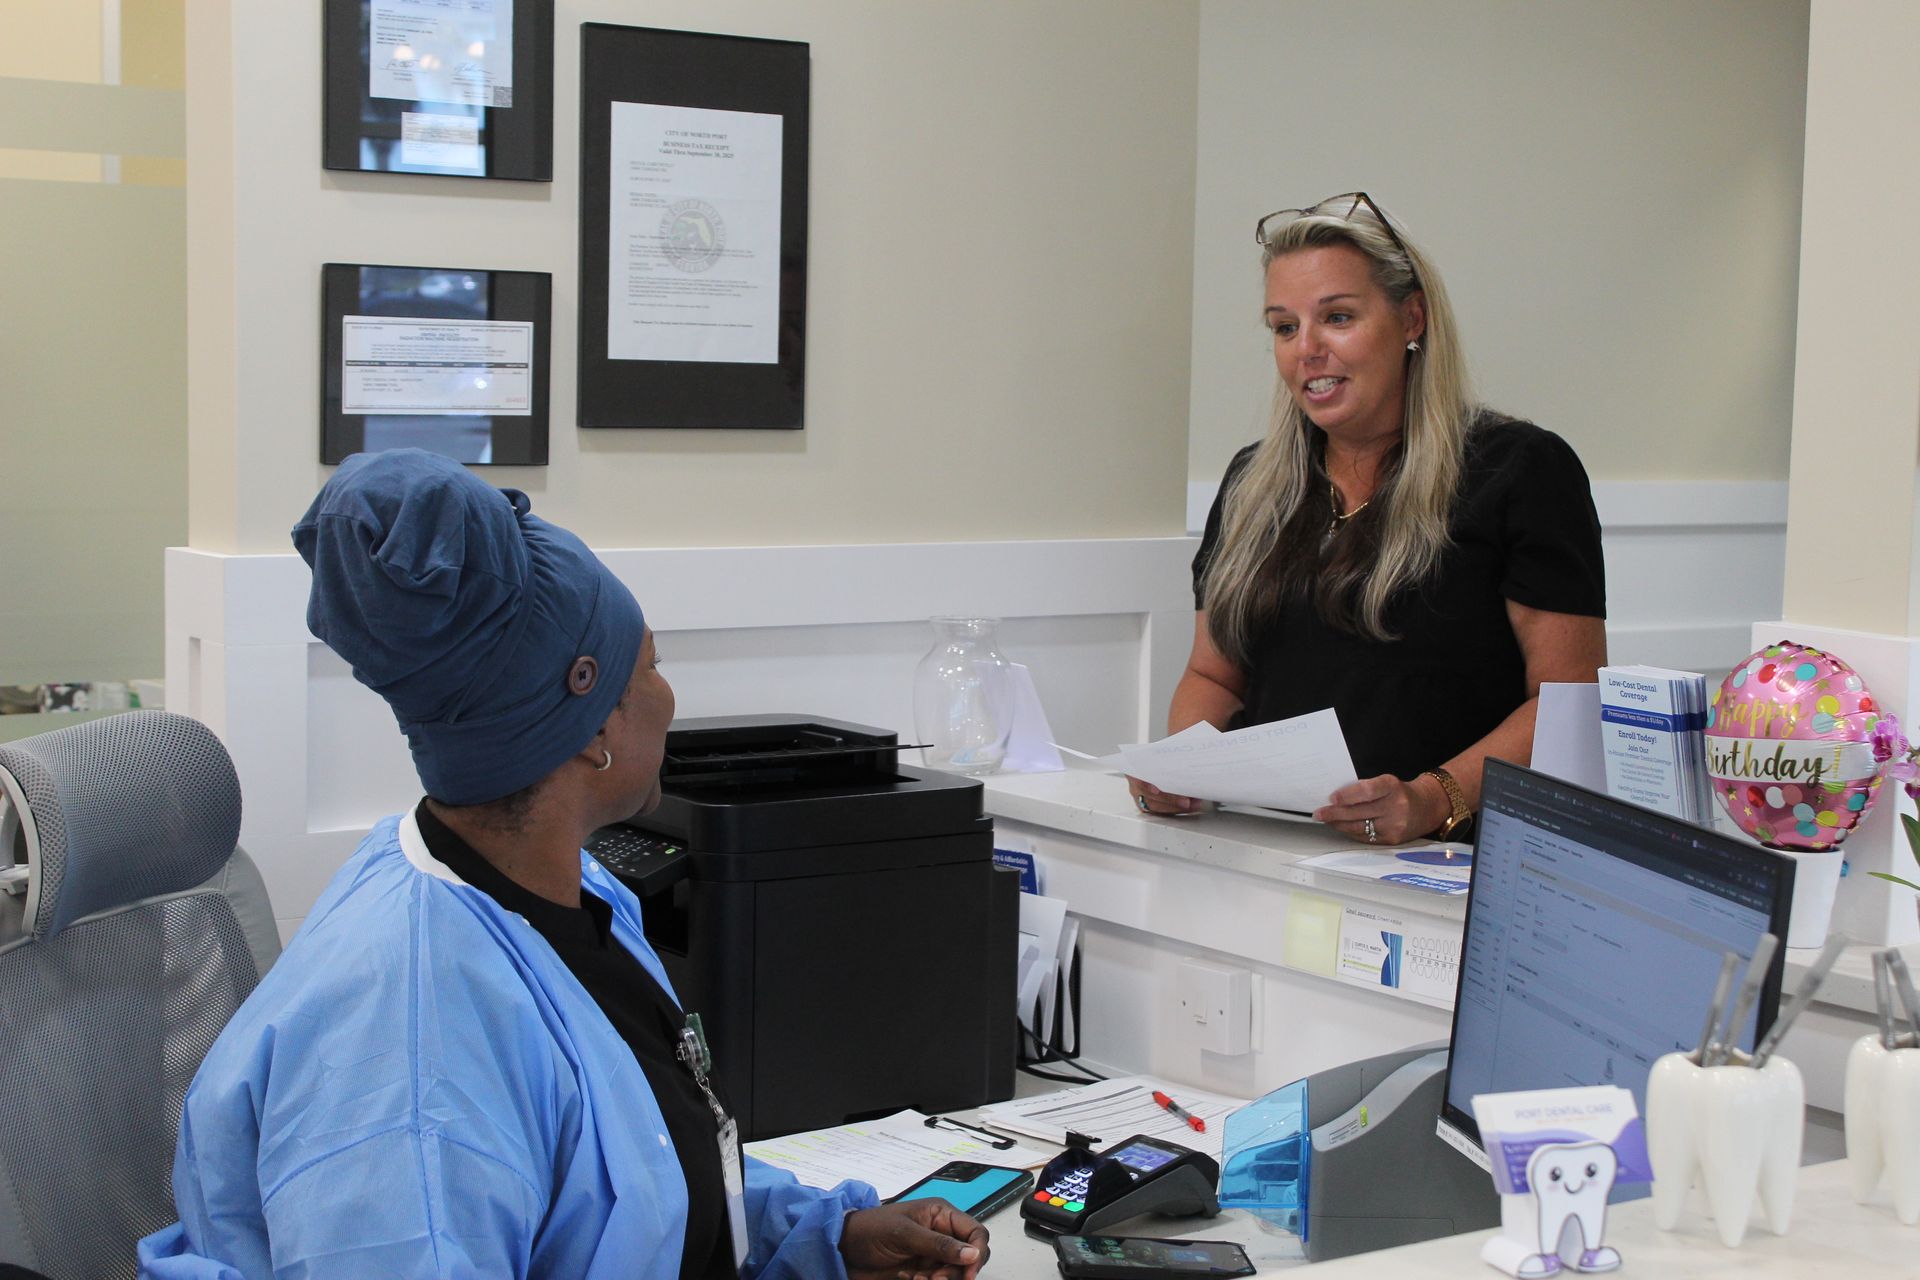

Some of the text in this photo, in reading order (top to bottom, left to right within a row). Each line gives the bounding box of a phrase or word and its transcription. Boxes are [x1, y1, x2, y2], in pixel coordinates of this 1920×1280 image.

[1608, 678, 1657, 692] Low-Cost Dental
[1619, 690, 1648, 702] Coverage
[1718, 692, 1808, 738] Happy
[1618, 730, 1656, 744] Enroll Today!
[1639, 746, 1649, 754] Our
